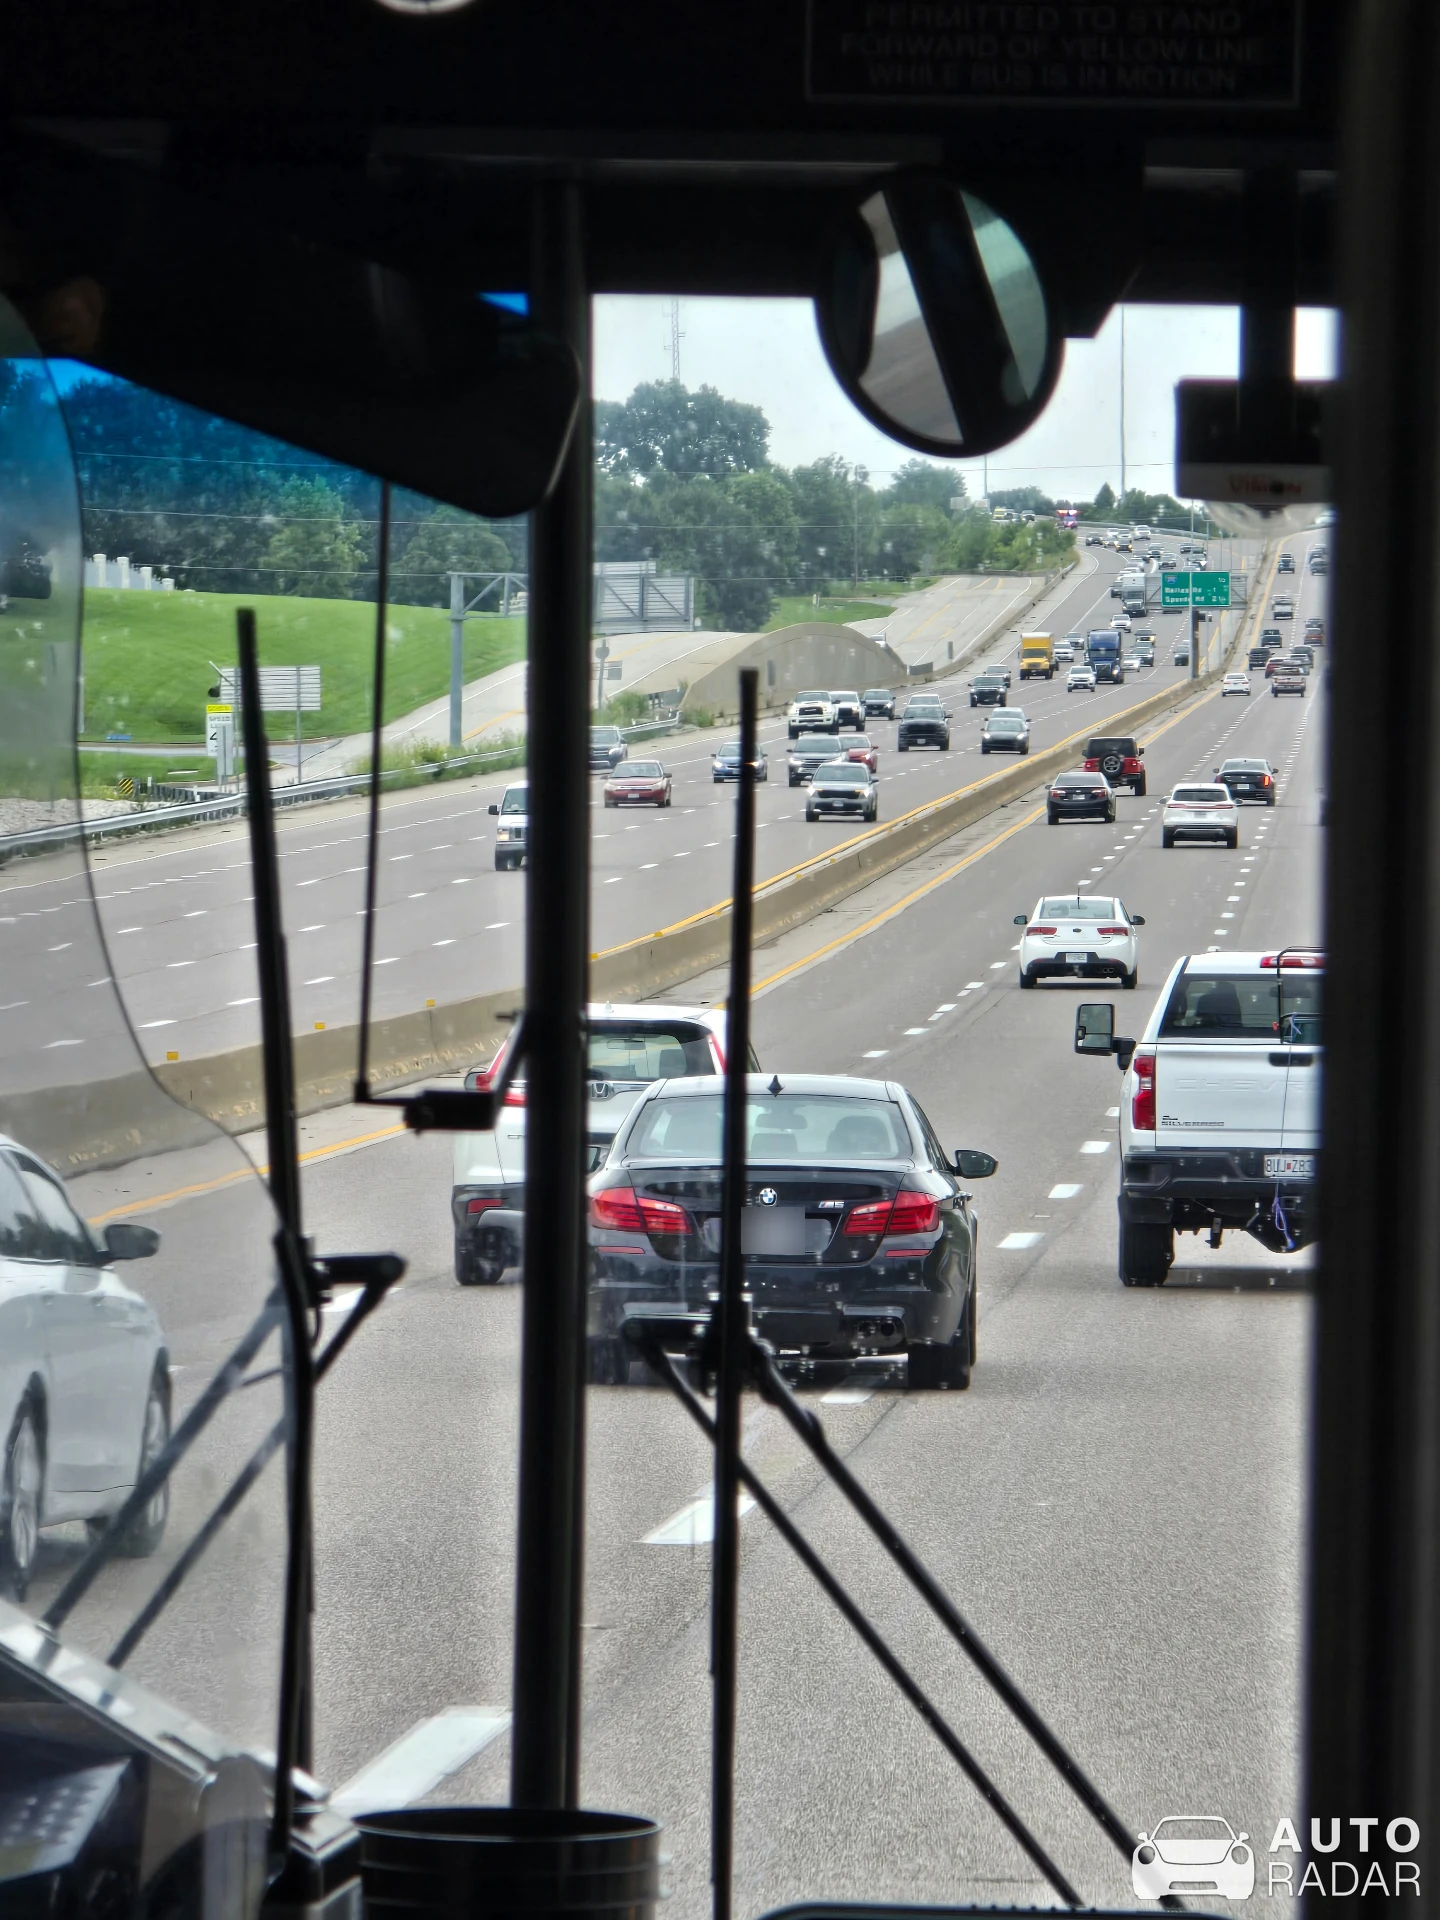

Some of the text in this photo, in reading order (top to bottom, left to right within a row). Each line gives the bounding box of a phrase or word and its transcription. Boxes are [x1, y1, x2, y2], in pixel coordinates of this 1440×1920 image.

[864, 6, 1242, 34] PERMITTED TO STAND
[841, 32, 1263, 63] FORWARD OF YELLOW LINE
[868, 60, 1238, 92] WHILE BUS IS IN MOTION
